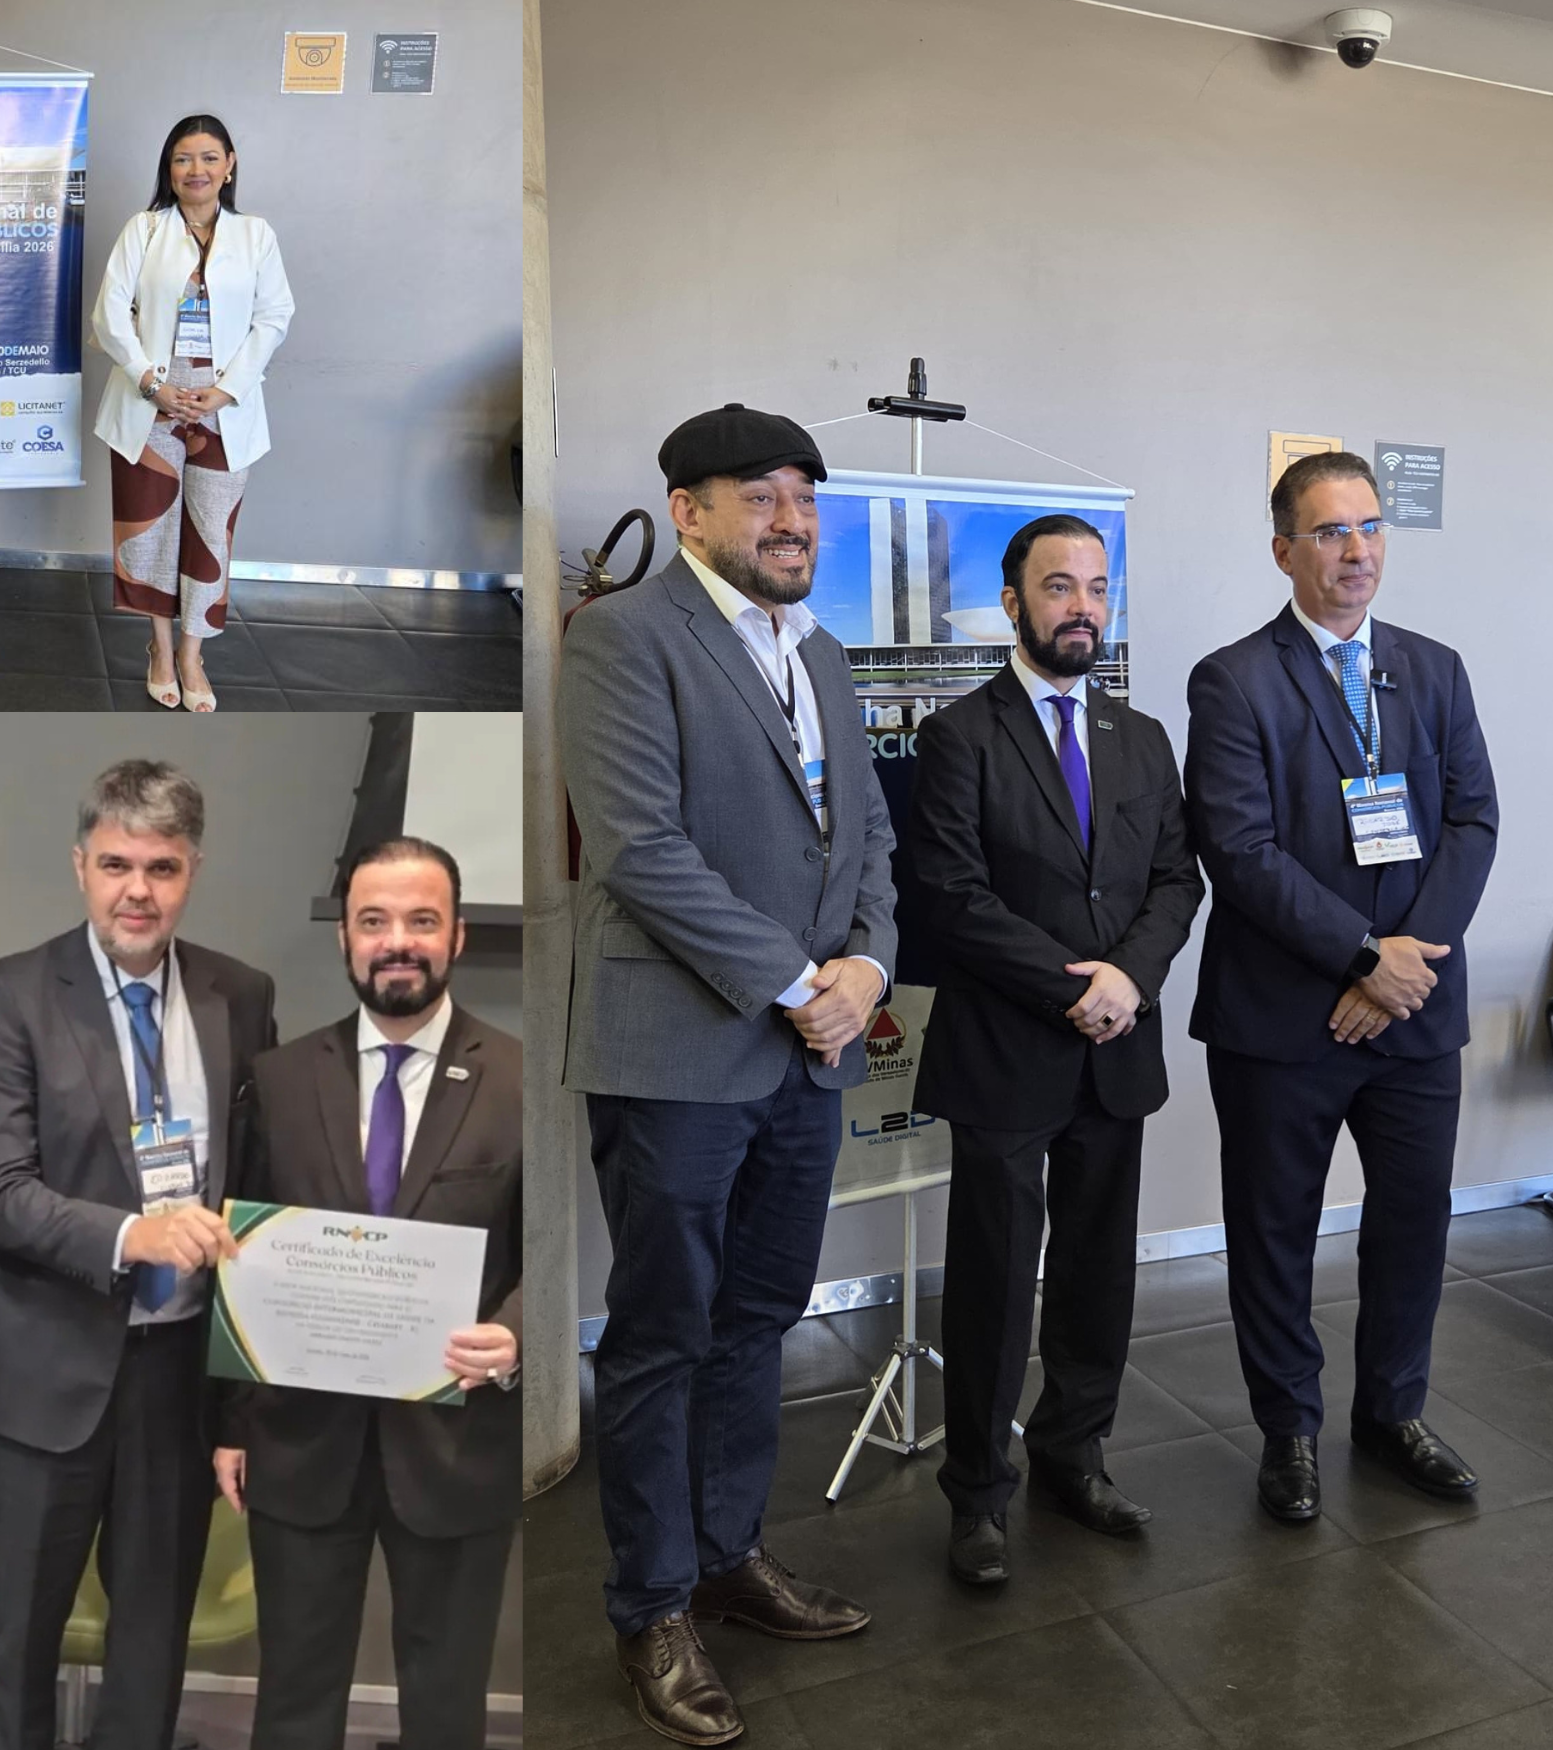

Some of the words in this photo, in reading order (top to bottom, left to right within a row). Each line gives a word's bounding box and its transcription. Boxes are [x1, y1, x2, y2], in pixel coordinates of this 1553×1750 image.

[33, 202, 58, 219] de
[8, 367, 27, 375] TCU
[22, 441, 64, 453] COESA
[270, 1238, 345, 1258] Certificado
